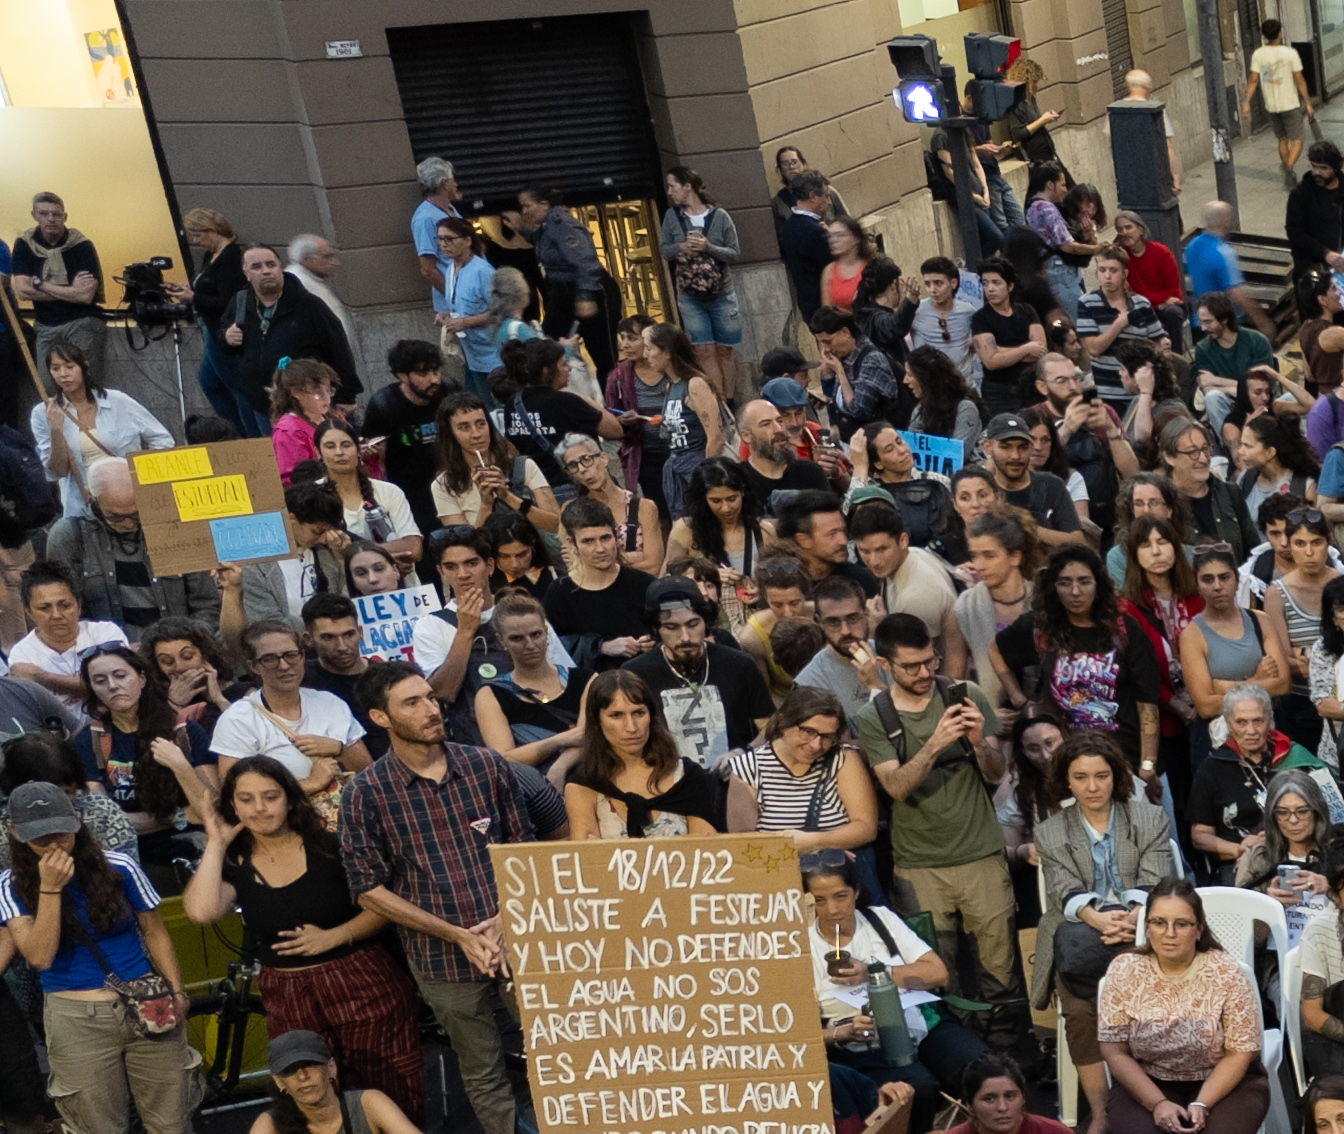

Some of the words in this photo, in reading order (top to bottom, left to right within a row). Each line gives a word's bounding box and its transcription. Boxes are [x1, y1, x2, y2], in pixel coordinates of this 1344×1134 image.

[510, 412, 541, 421] TOOS
[919, 436, 931, 451] EL
[358, 593, 407, 624] LEY
[413, 594, 430, 608] DE
[359, 617, 419, 655] LACIA
[504, 855, 540, 897] SI
[551, 853, 599, 895] EL
[608, 845, 735, 894] 18/12/22
[505, 897, 621, 936] SALISTE
[641, 897, 668, 928] A
[690, 888, 804, 926] FESTEJAR
[513, 942, 529, 976] Y
[538, 938, 605, 974] HOY
[625, 937, 672, 971] NO
[678, 930, 801, 964] DEFENDES
[521, 983, 558, 1009] EL
[568, 977, 635, 1007] AGUA
[653, 974, 697, 1000] NO
[709, 967, 761, 996] SOS
[530, 1004, 696, 1049] ARGENTINO,
[700, 1002, 794, 1038] SERLO
[536, 1052, 575, 1085] ES
[584, 1044, 665, 1080] AMAR
[671, 1044, 696, 1071] LA
[702, 1044, 785, 1070] PATRIA
[789, 1044, 807, 1069] Y
[543, 1086, 693, 1126] DEFENDER
[700, 1084, 737, 1115] EL
[738, 1081, 801, 1113] AGUA
[808, 1080, 825, 1110] Y
